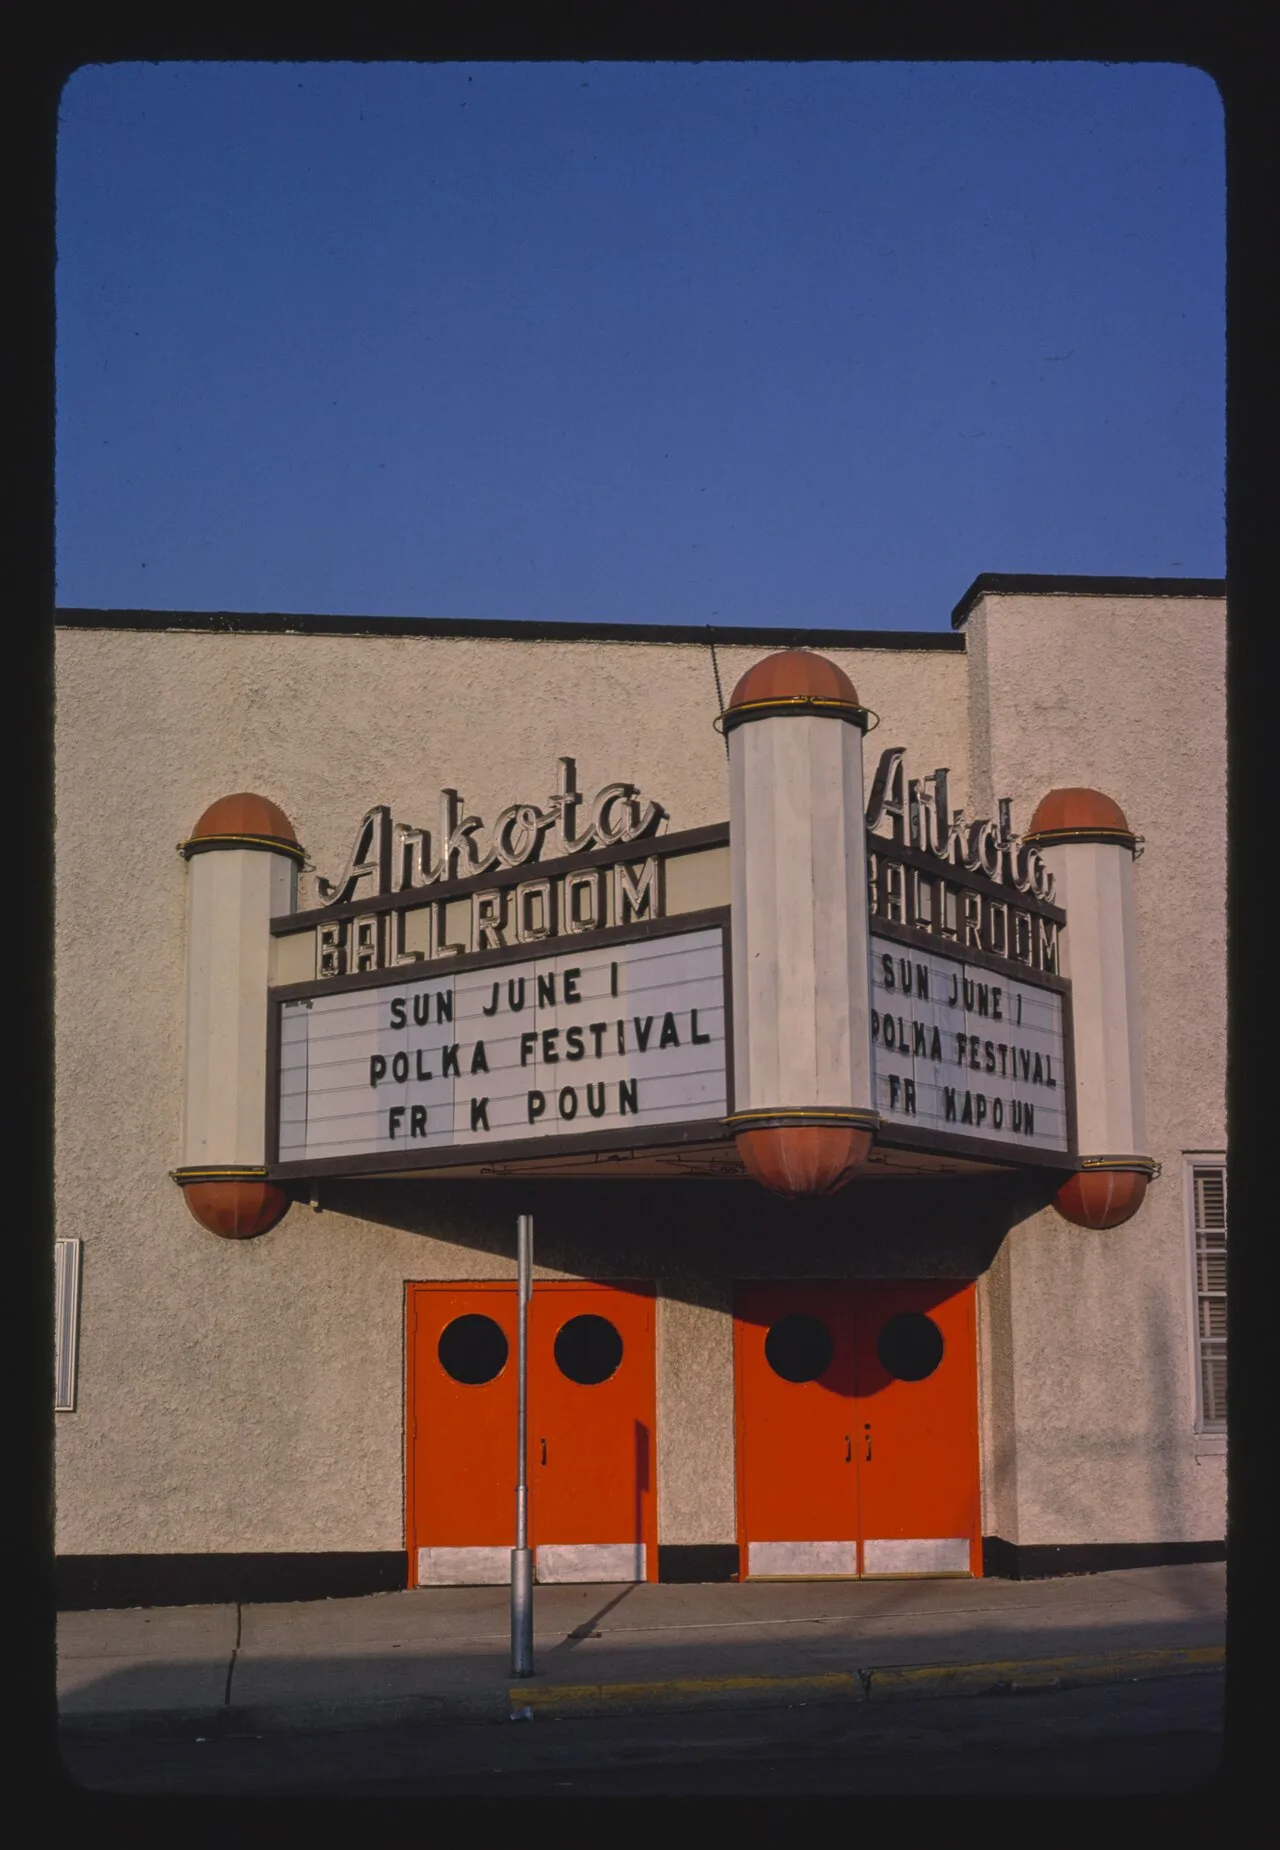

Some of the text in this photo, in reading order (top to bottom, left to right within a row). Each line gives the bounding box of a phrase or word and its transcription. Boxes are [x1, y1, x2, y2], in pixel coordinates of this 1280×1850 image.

[315, 756, 668, 906] Arkota
[315, 854, 664, 978] BALLROOM
[389, 989, 454, 1030] SUN
[483, 967, 581, 1016] JUNE
[882, 953, 929, 999] SUN
[948, 972, 1002, 1019] JUNE
[370, 1008, 710, 1086] POLKA FESTIVAL
[871, 1008, 1056, 1087] POLKA FESTIVAL
[388, 1104, 427, 1139] FR
[888, 1074, 1035, 1136] FR KAPOUN
